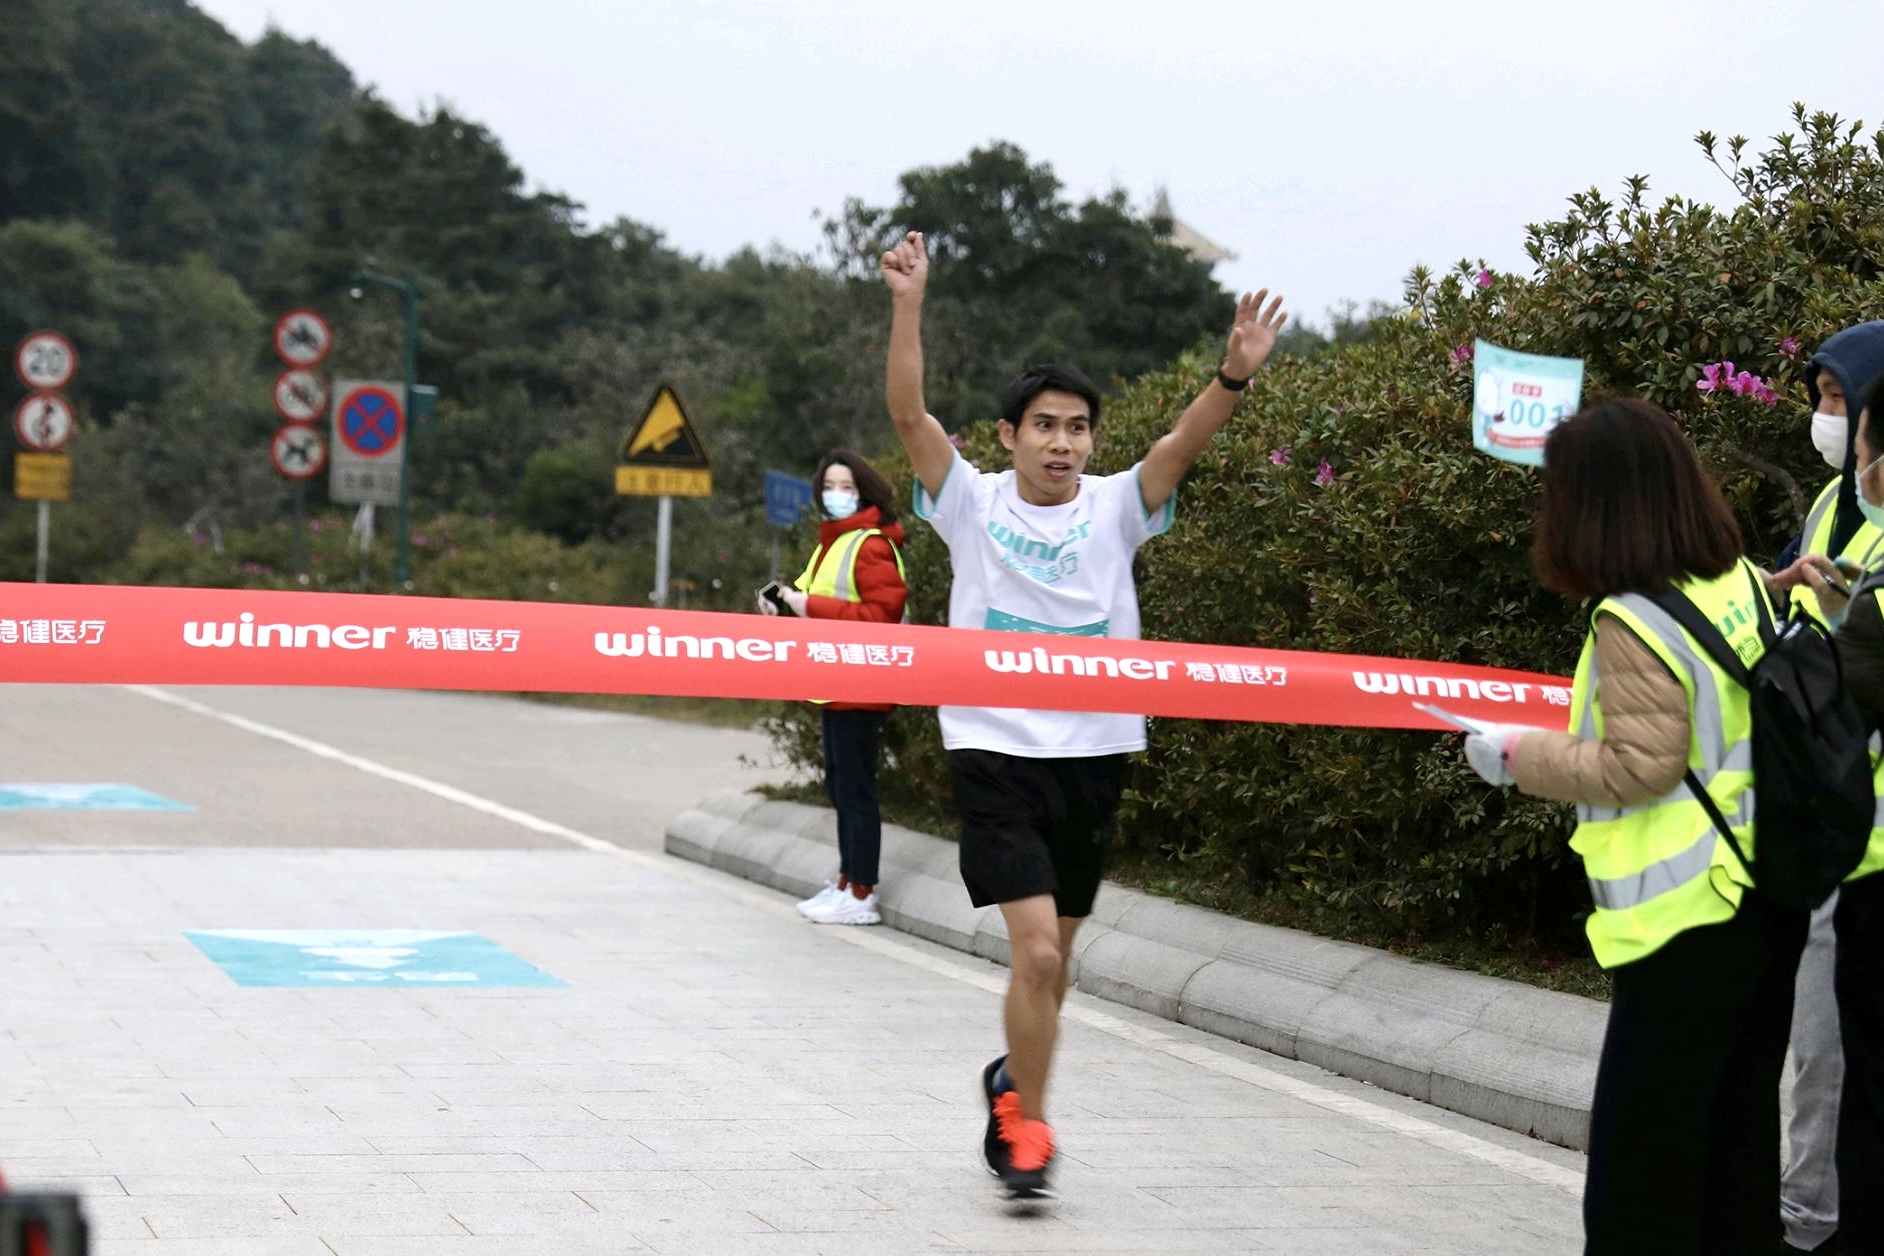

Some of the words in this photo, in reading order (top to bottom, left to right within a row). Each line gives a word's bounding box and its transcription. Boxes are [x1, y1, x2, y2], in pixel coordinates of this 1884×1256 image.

[28, 343, 62, 376] 20
[183, 612, 396, 650] winner
[406, 626, 521, 652] 稳健医疗
[594, 625, 797, 661] winner
[806, 641, 915, 667] 稳健医疗
[984, 647, 1176, 680] winner
[1185, 661, 1287, 686] 稳健医疗
[1352, 671, 1532, 703] winner
